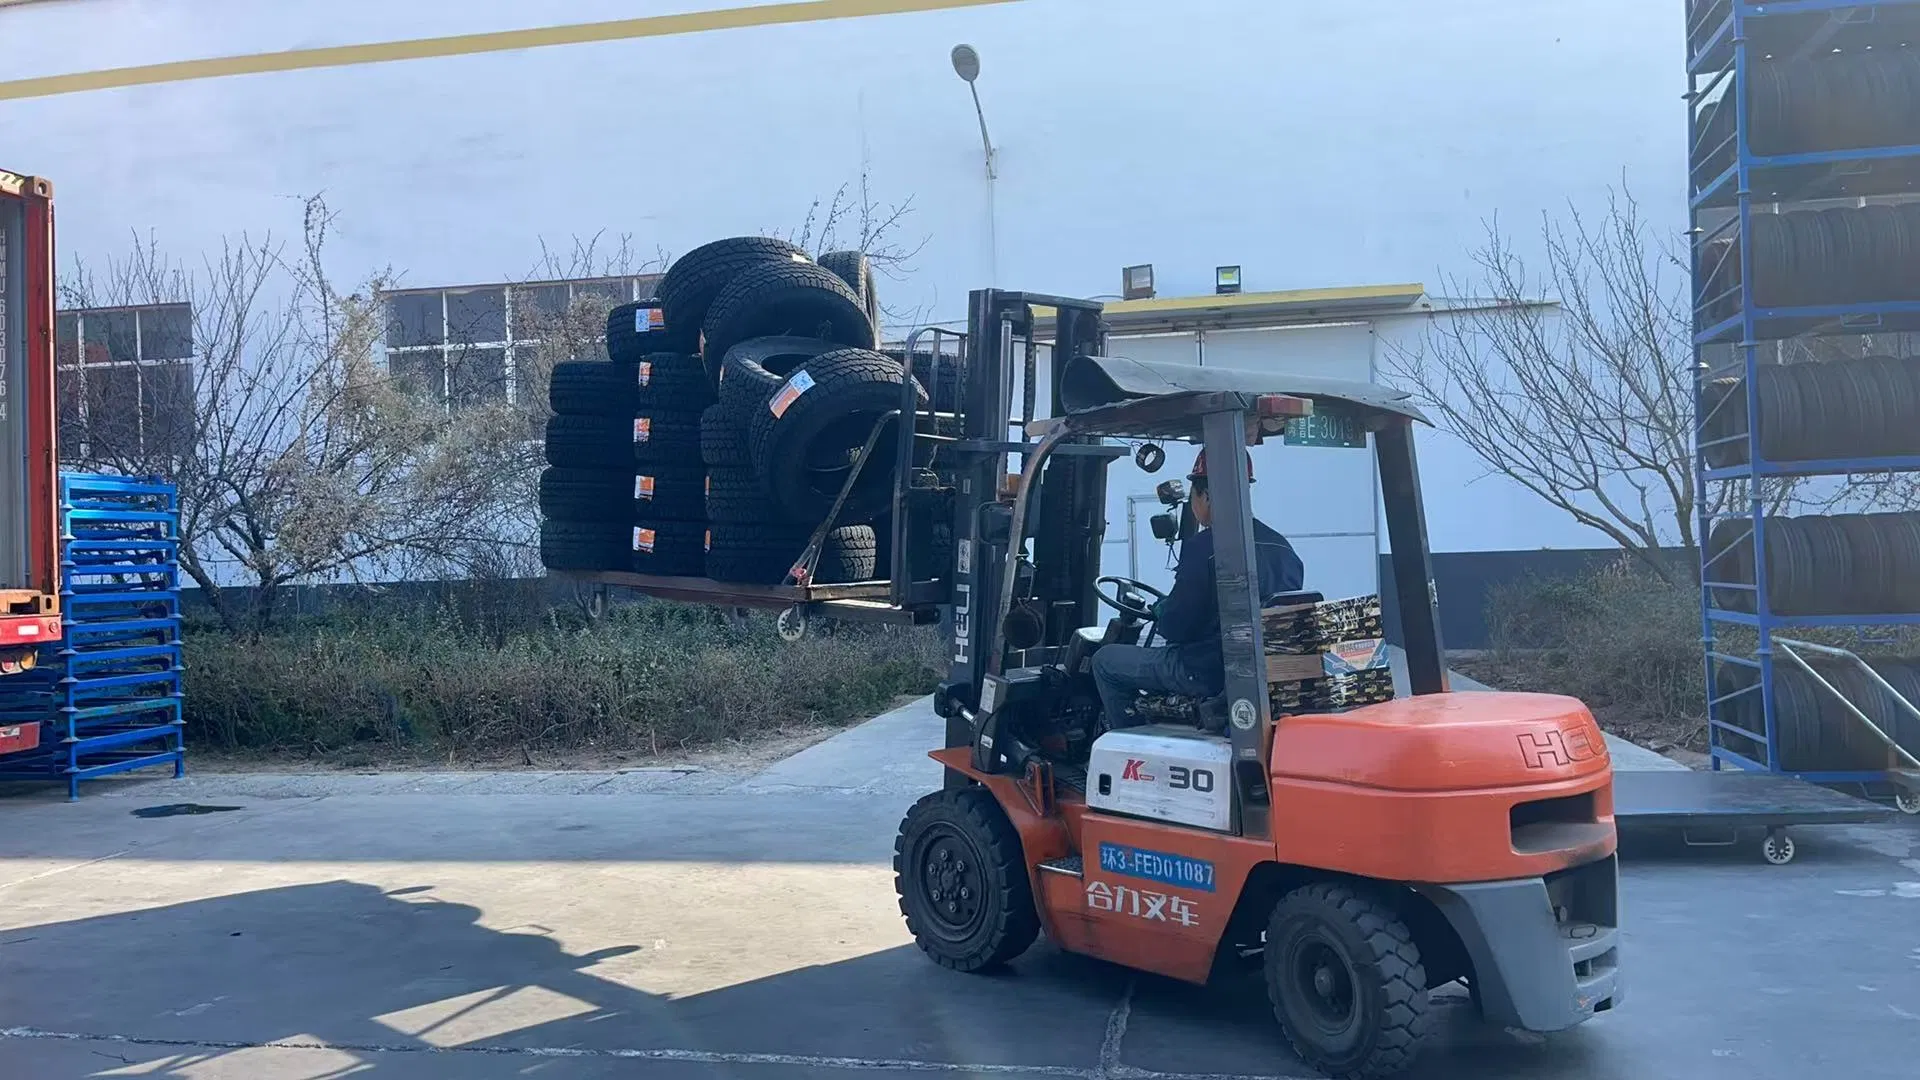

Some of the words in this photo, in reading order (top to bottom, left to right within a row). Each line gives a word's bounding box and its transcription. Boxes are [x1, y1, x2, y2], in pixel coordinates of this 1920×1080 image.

[955, 584, 970, 664] HELI
[1122, 758, 1145, 781] K
[1169, 765, 1214, 793] 30
[1101, 846, 1214, 885] 环3-FED01087
[1086, 880, 1200, 927] 合力叉车
